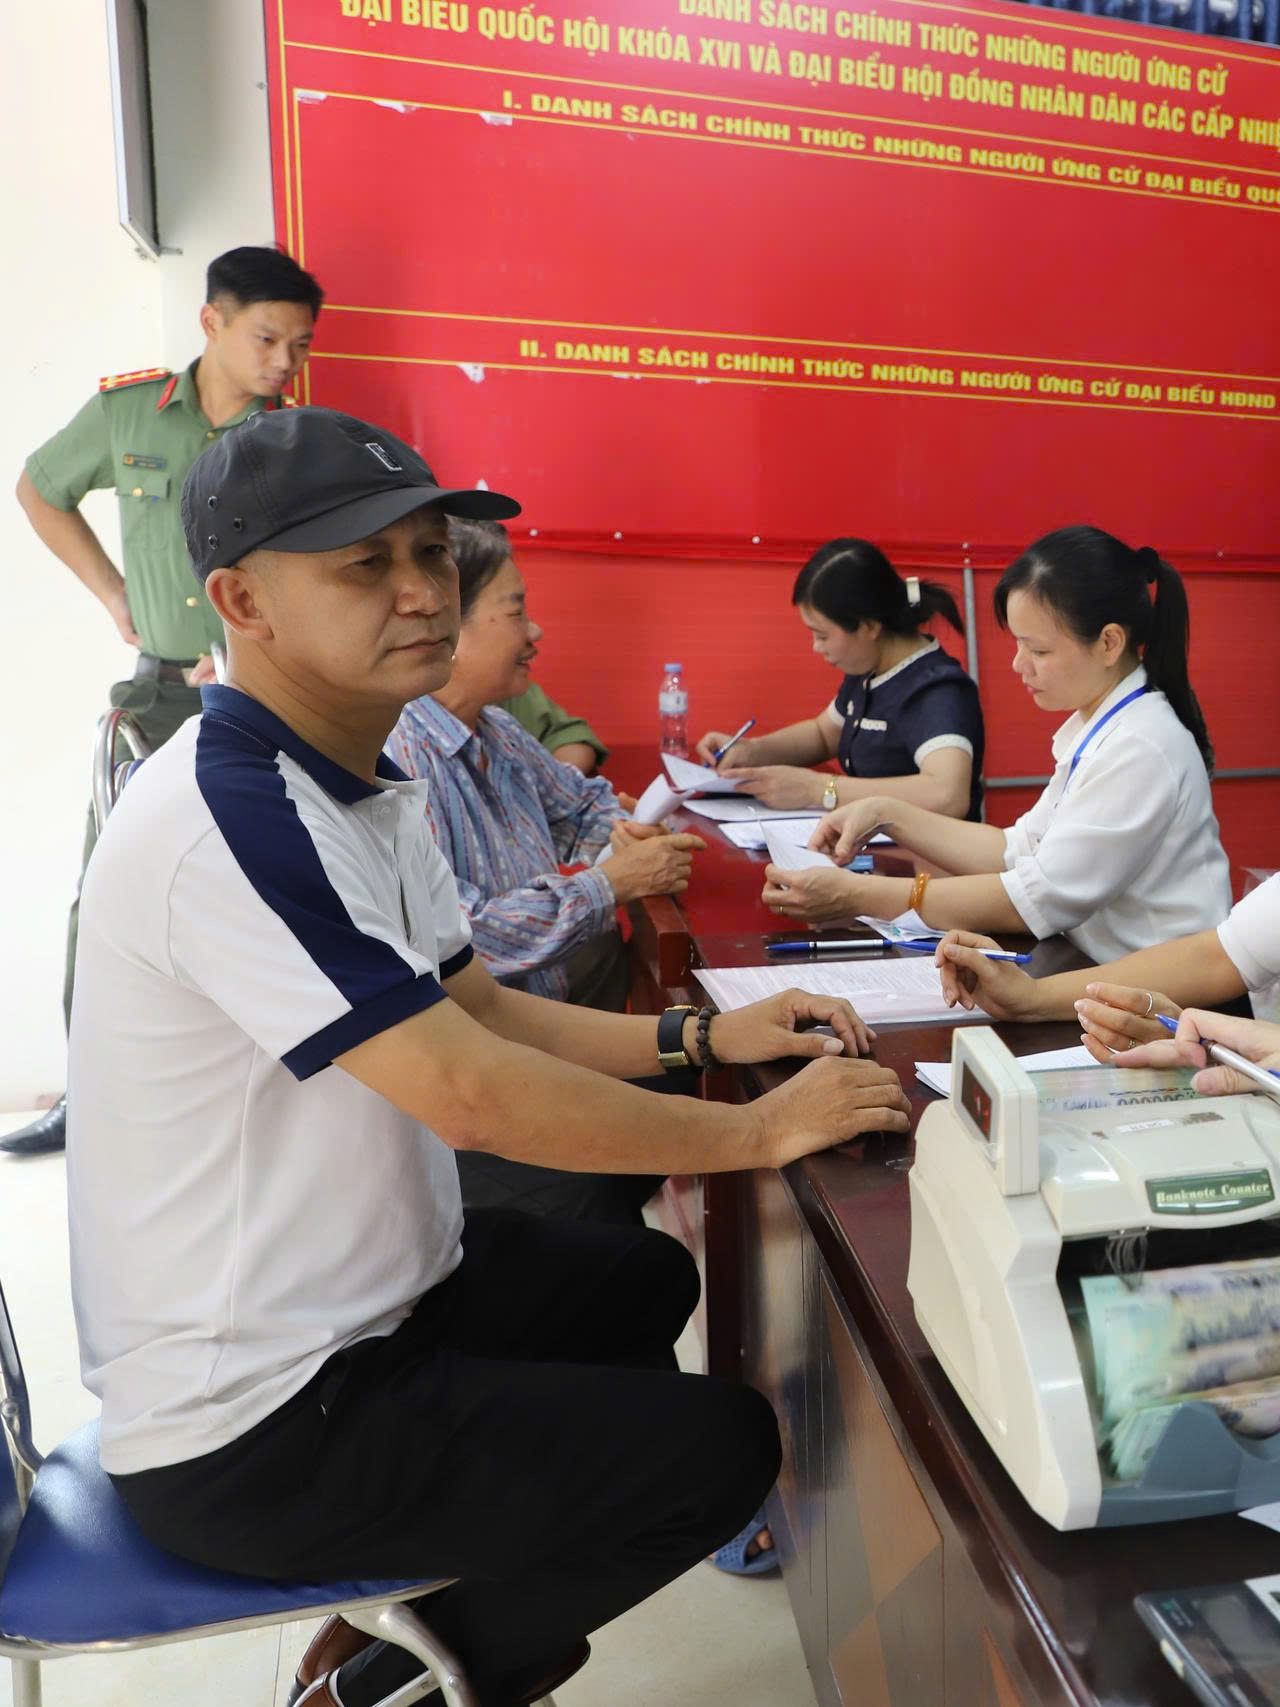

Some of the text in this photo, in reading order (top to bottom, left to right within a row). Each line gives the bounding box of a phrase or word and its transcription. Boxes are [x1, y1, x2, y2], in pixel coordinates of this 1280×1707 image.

[478, 3, 555, 45] QUỐC
[564, 17, 610, 57] HỘI
[618, 26, 690, 64] KHÓA
[700, 37, 741, 69] XVI
[749, 41, 782, 75] VÀ
[789, 50, 831, 87] ĐẠI
[839, 51, 896, 91] BIỂU
[902, 63, 943, 100] HỘI
[949, 67, 1014, 108] ĐỒNG
[1020, 83, 1085, 119] NHÂN
[1090, 92, 1136, 126] DÂN
[1142, 100, 1186, 133] CÁC
[1191, 104, 1234, 139] CẤP
[835, 9, 912, 47] CHÍNH
[919, 23, 978, 58] THỨC
[986, 34, 1065, 71] NHỮNG
[1072, 48, 1140, 83] NGƯỜI
[1146, 56, 1192, 91] ỨNG
[1197, 62, 1227, 97] CỬ
[503, 89, 522, 109] I.
[531, 93, 613, 120] DANH
[621, 104, 698, 130] SÁCH
[706, 113, 790, 142] CHÍNH
[798, 124, 865, 150] THỨC
[874, 135, 962, 163] NHỮNG
[970, 148, 1045, 174] NGƯỜI
[1052, 155, 1101, 180] ỨNG
[1108, 164, 1141, 186] CỬ
[1145, 172, 1184, 192] ĐẠI
[1190, 177, 1240, 198] BIỂU
[520, 340, 547, 358] II.
[555, 341, 630, 363] DANH
[637, 346, 708, 368] SÁCH
[716, 353, 795, 374] CHÍNH
[803, 358, 864, 380] THỨC
[871, 363, 954, 386] NHỮNG
[961, 371, 1031, 390] NGƯỜI
[1038, 373, 1085, 395] ỨNG
[1090, 377, 1120, 398] CỬ
[1125, 384, 1161, 402] ĐẠI
[1167, 384, 1215, 404] BIỂU
[1156, 1182, 1270, 1203] Banknote Counter
